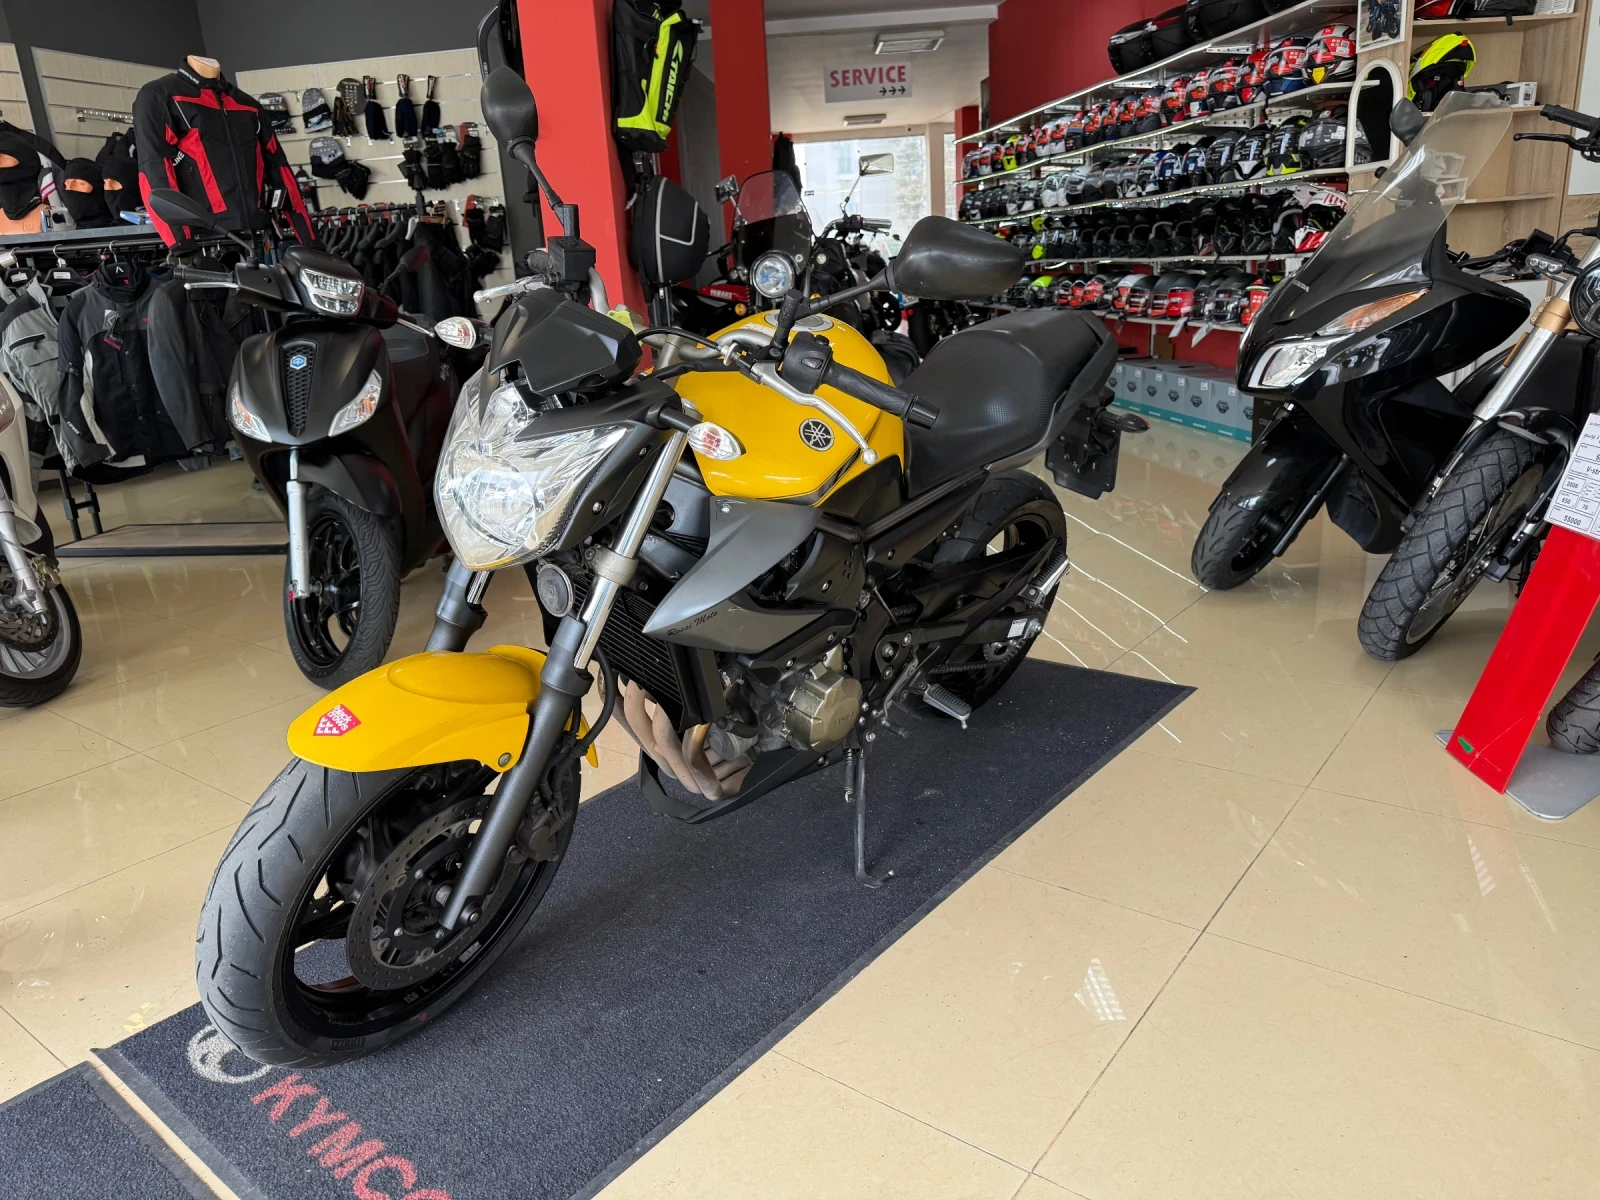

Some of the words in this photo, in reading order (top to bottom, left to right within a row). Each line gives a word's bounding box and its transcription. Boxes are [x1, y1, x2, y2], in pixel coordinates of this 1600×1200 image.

[829, 65, 907, 88] SERVICE
[661, 60, 679, 122] TAICHI
[666, 622, 693, 637] Rossi
[327, 710, 349, 732] crows
[333, 704, 353, 725] black
[250, 1072, 452, 1200] KYMC
